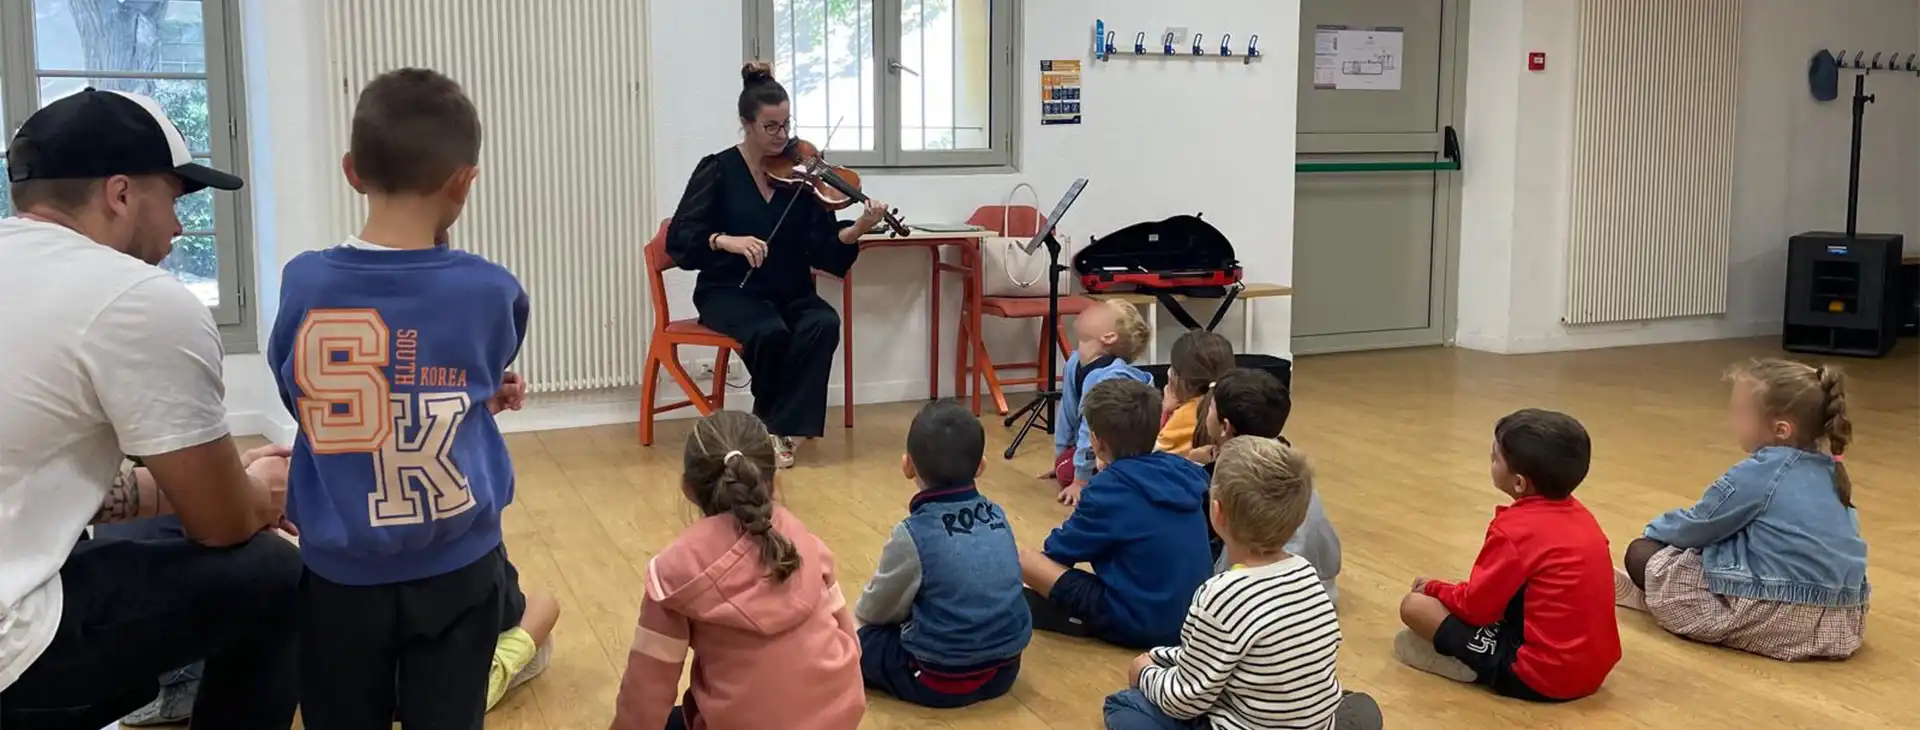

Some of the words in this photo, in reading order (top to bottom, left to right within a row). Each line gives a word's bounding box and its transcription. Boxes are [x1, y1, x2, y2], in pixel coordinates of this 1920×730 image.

[395, 328, 418, 385] SOUTH
[420, 366, 467, 387] KOREA
[941, 502, 1001, 537] ROCK
